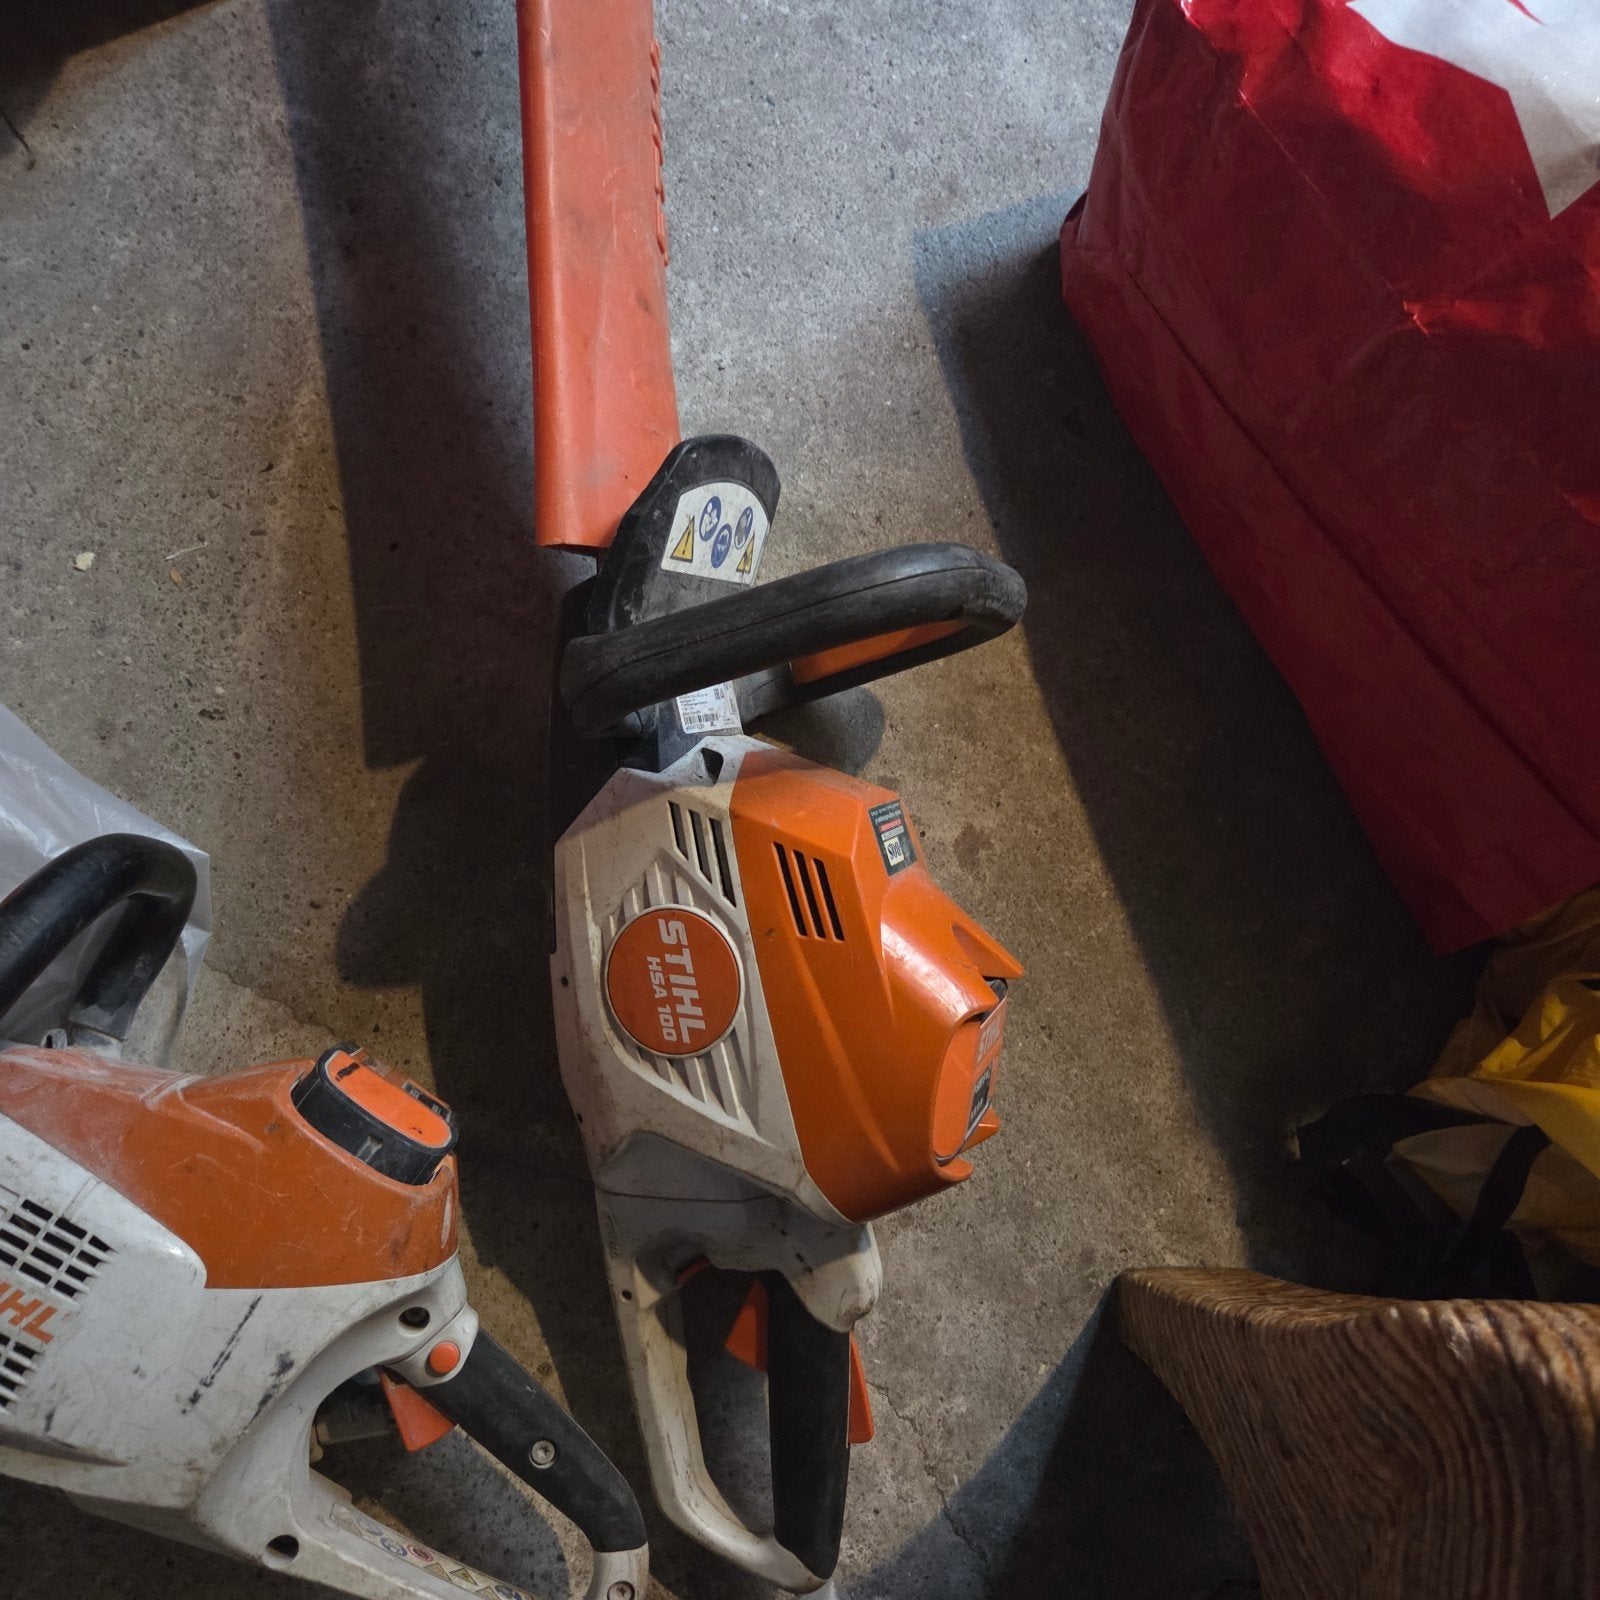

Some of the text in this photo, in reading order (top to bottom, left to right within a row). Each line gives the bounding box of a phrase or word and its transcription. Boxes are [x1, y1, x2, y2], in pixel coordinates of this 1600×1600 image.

[646, 956, 678, 1042] HSA 100
[658, 918, 706, 1044] STIHL
